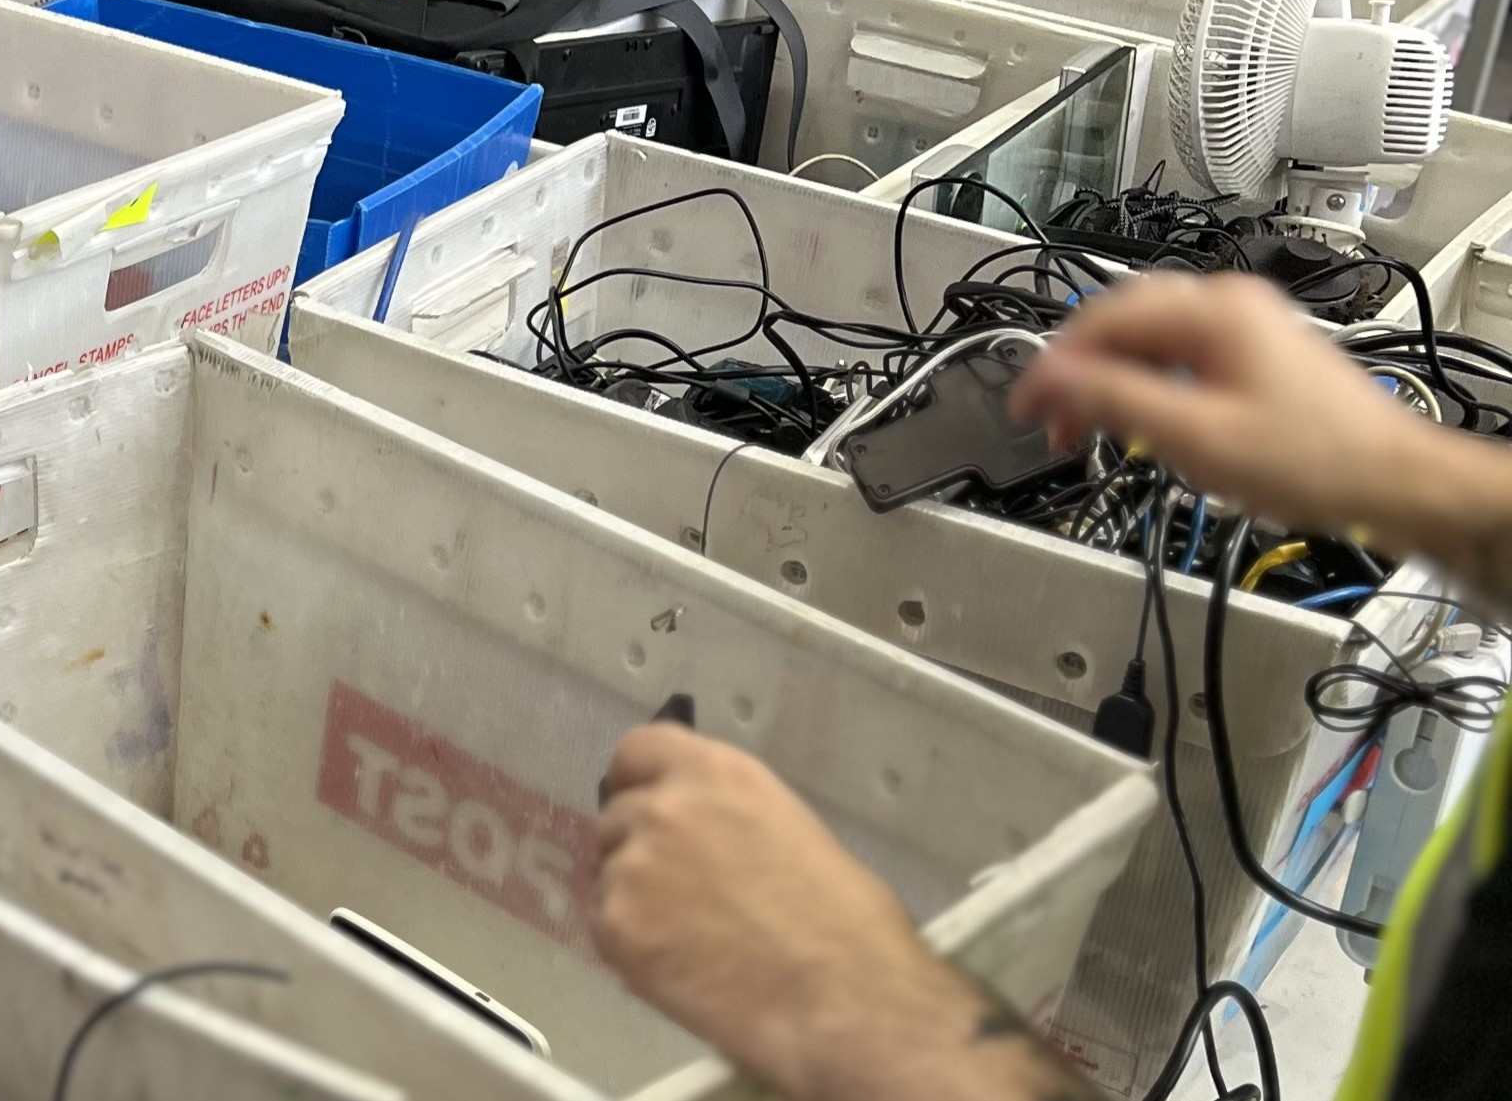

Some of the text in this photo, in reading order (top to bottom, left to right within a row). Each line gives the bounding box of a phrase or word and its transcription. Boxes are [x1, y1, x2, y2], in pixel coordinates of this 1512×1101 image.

[181, 301, 214, 329] FACE
[216, 276, 265, 314] LETTERS
[261, 292, 285, 315] END
